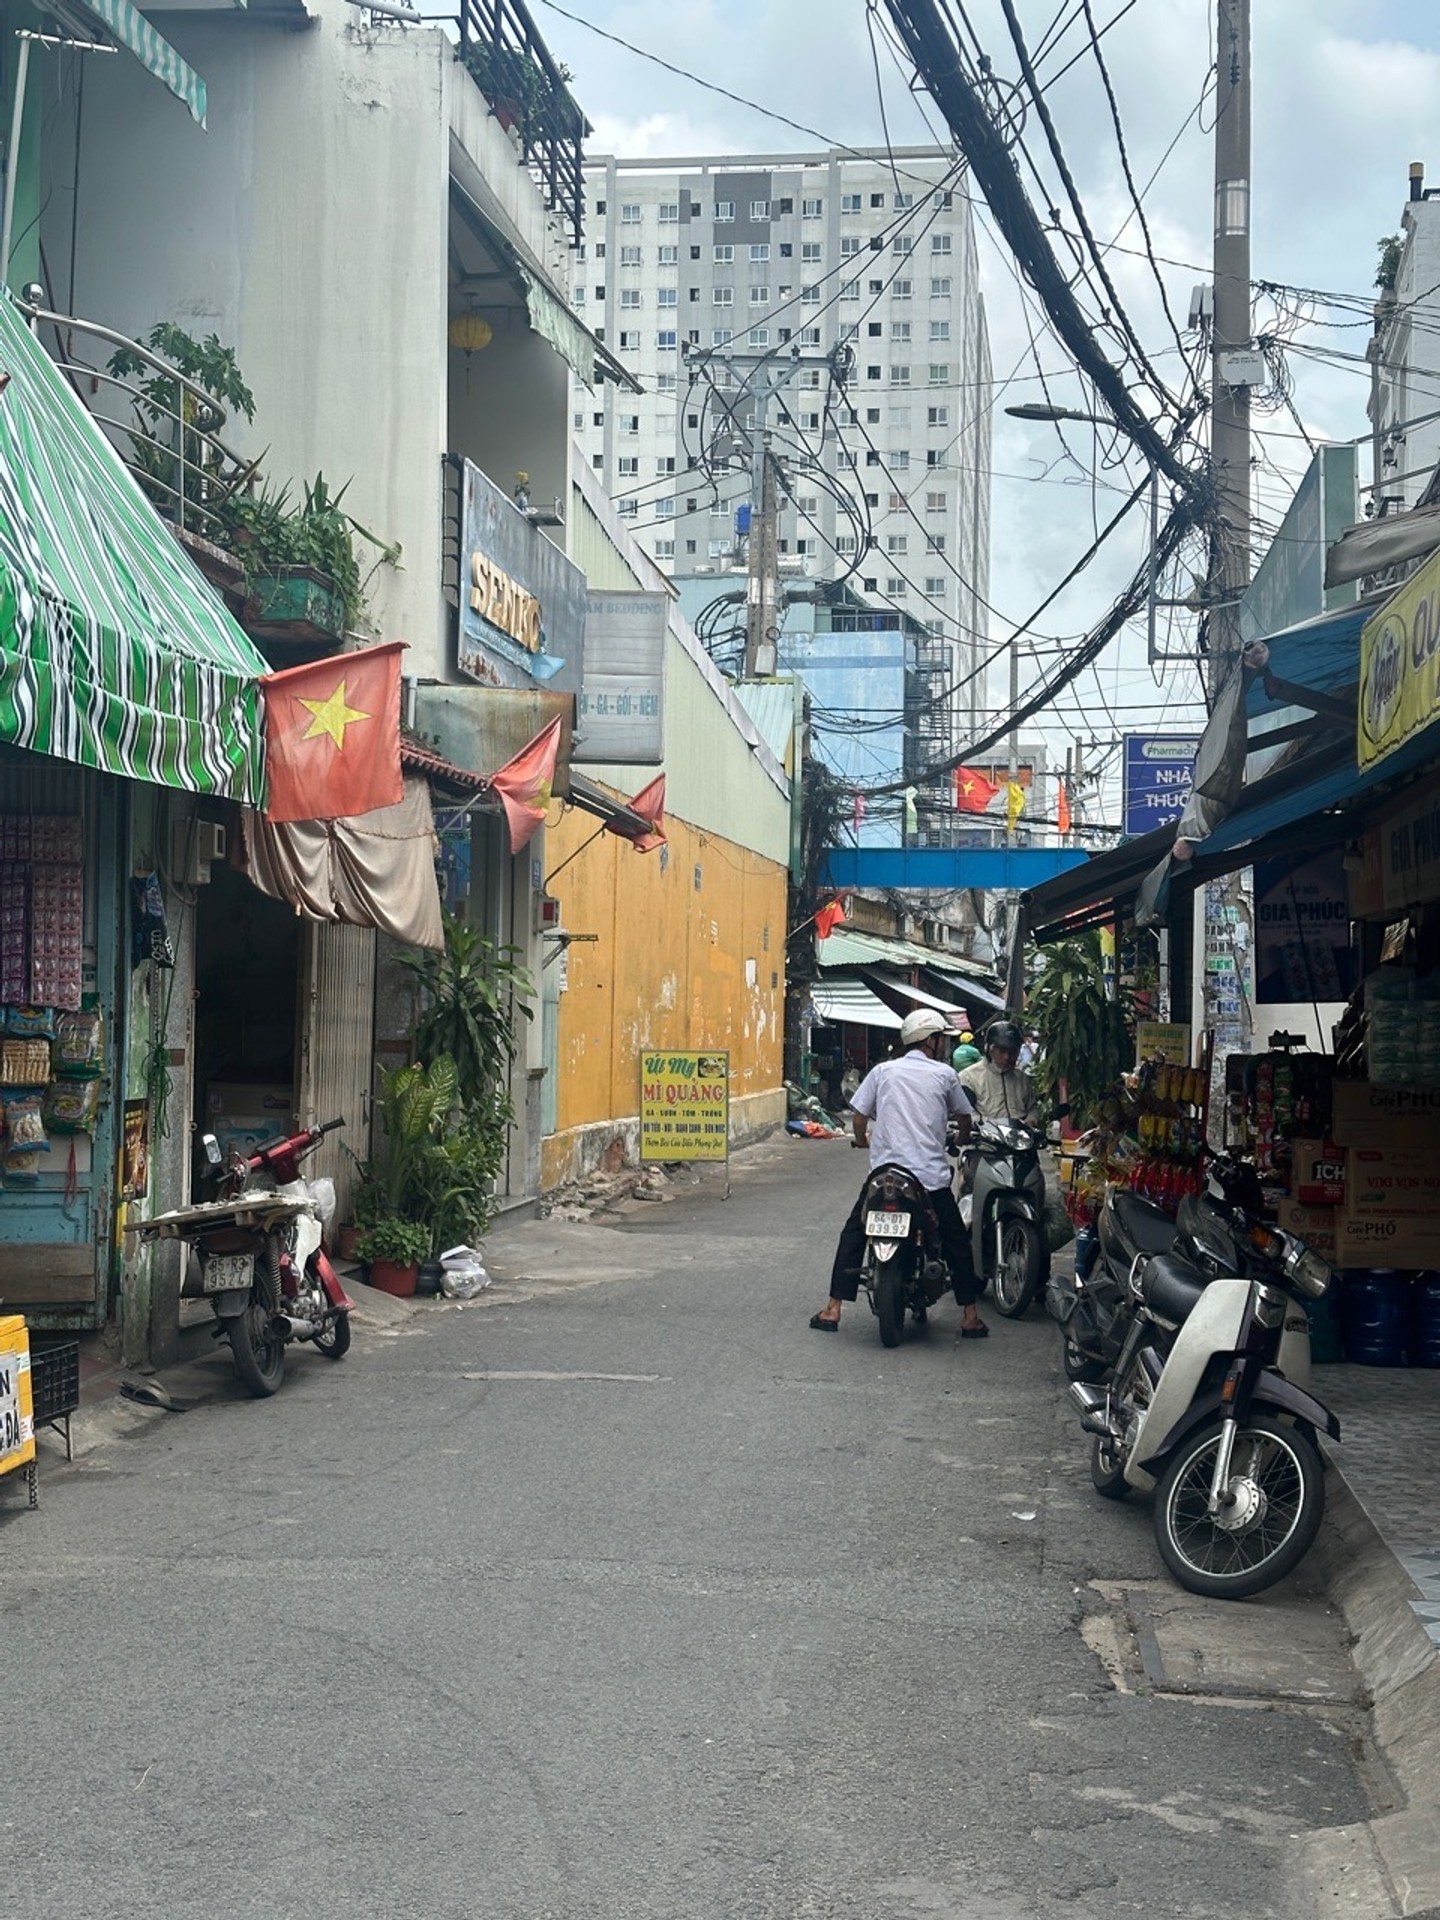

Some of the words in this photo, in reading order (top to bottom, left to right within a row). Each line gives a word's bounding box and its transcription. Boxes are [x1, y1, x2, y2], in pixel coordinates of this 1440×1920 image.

[470, 551, 541, 654] SENKO
[1260, 903, 1291, 921] GIA
[1294, 897, 1346, 920] PHÚC
[644, 1080, 662, 1101] MÌ
[666, 1077, 724, 1105] QUẢNG
[1365, 1218, 1397, 1236] PHỐ
